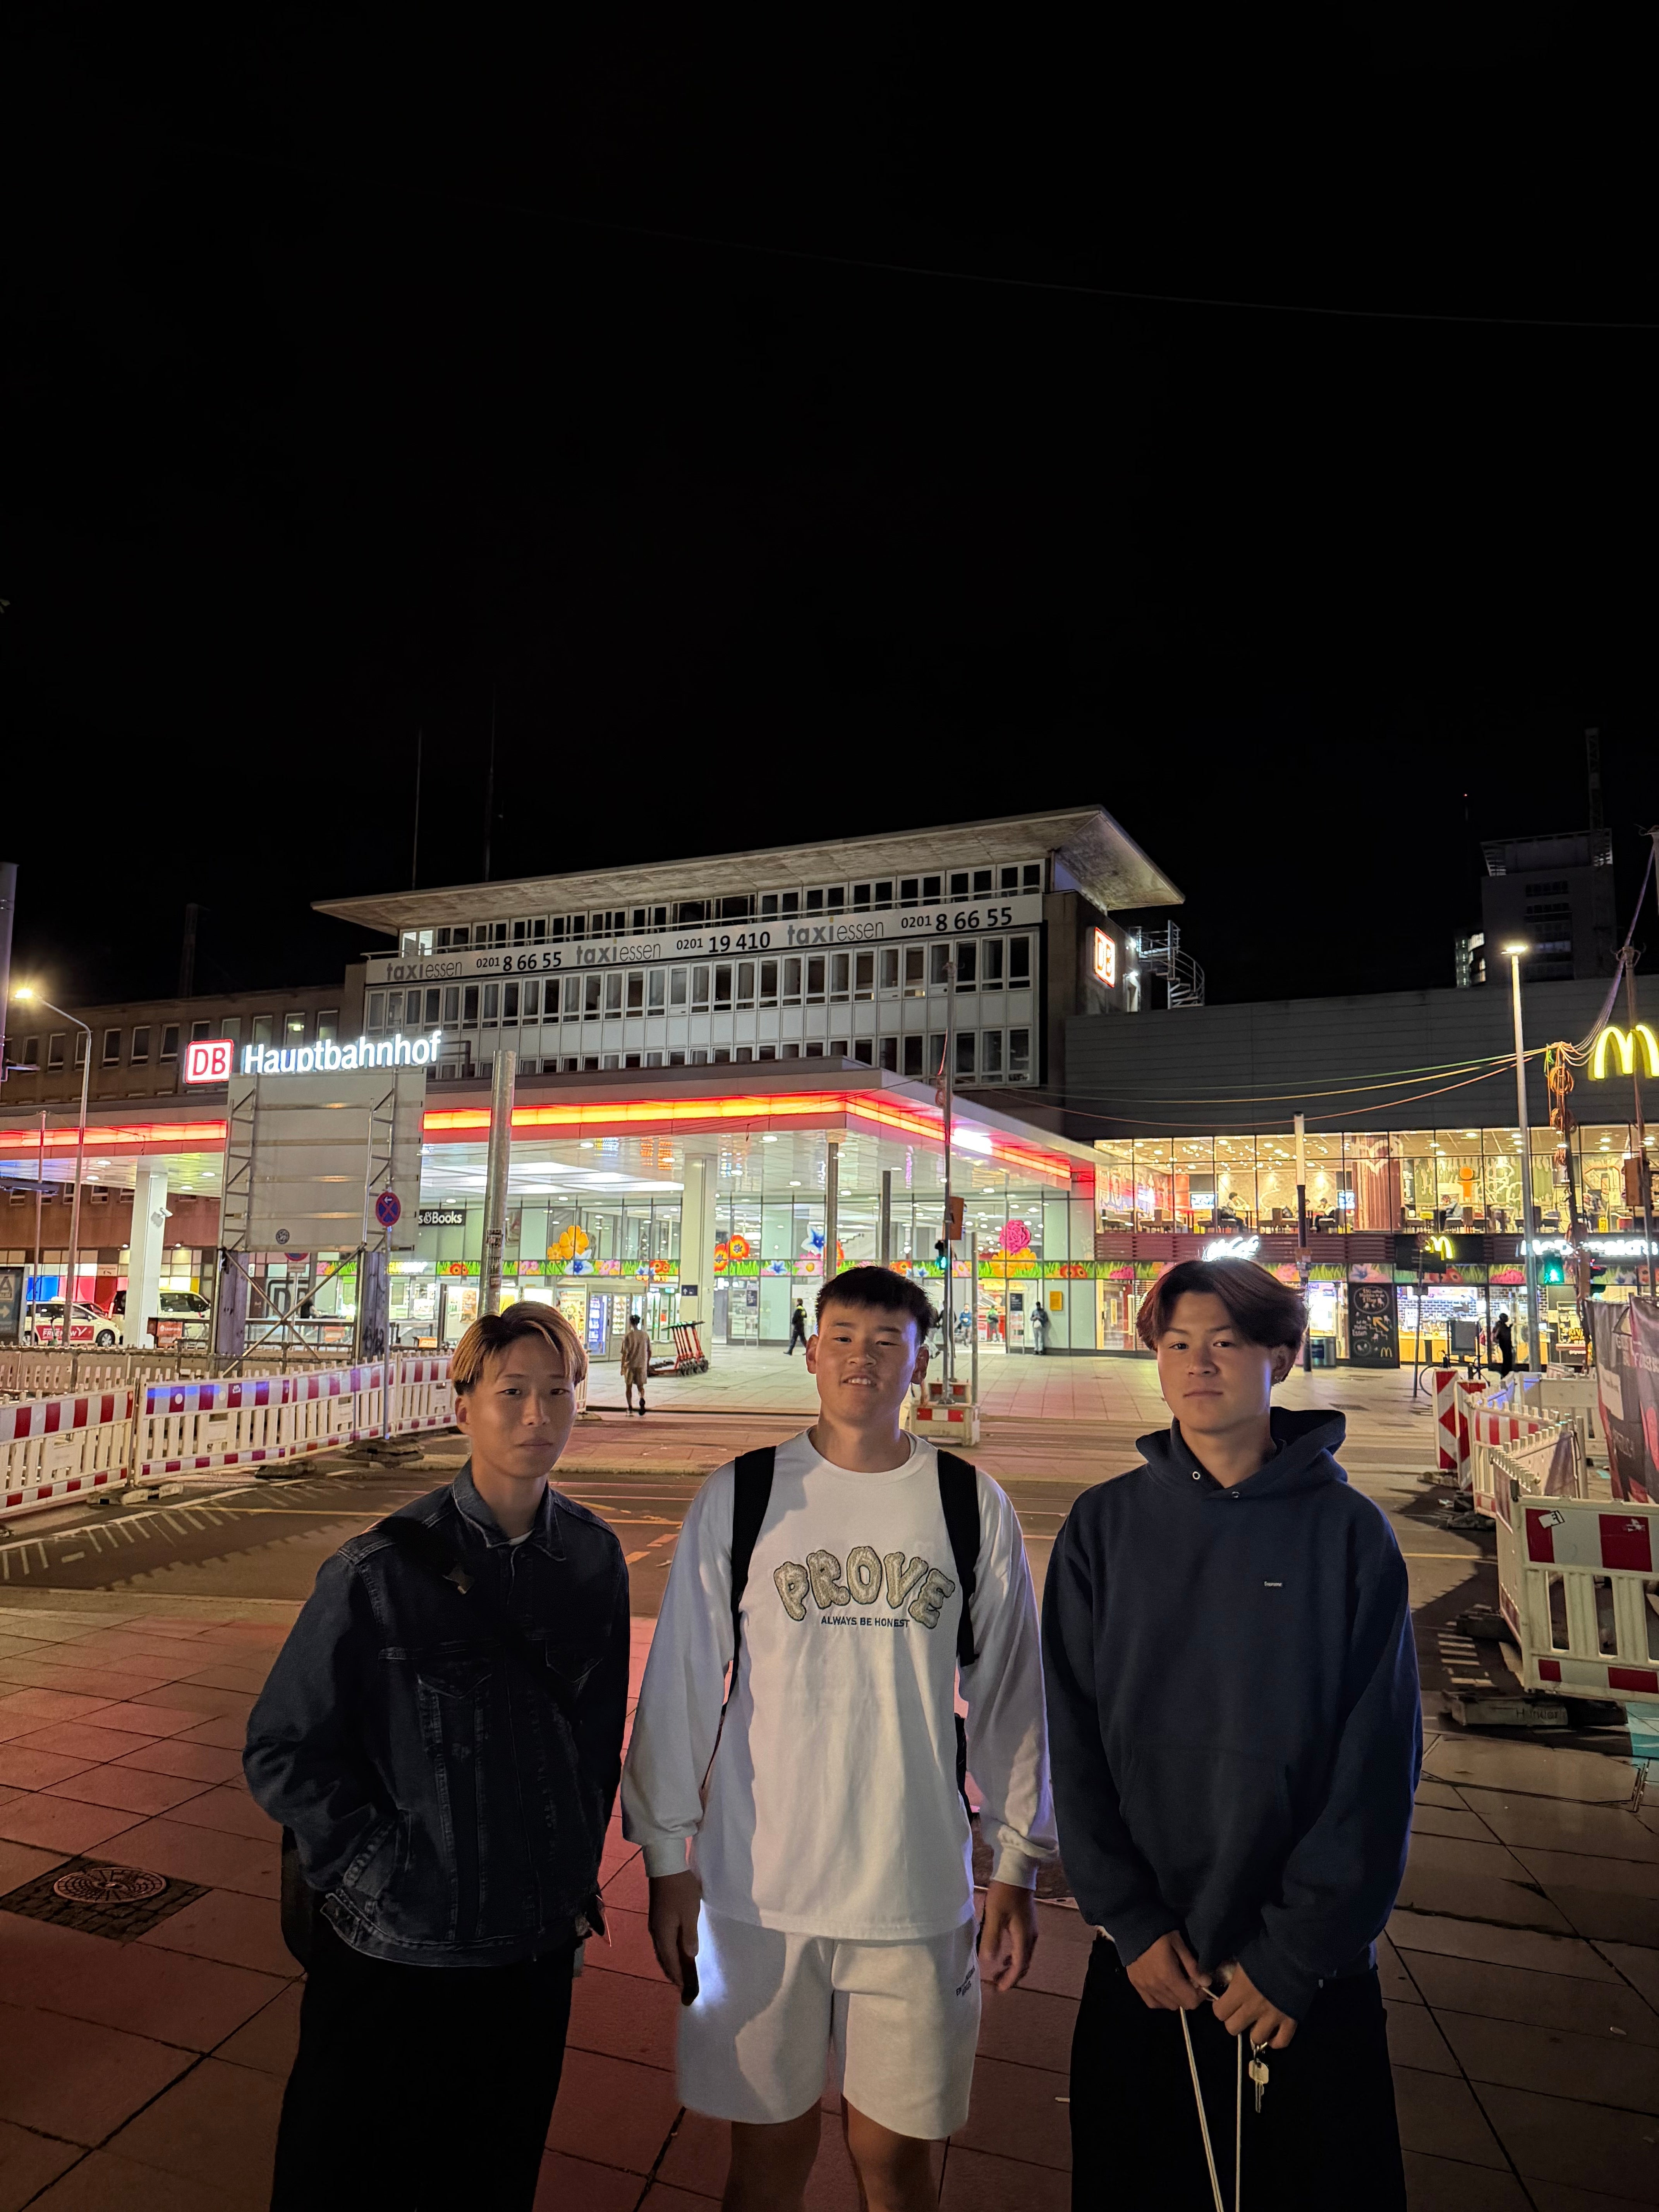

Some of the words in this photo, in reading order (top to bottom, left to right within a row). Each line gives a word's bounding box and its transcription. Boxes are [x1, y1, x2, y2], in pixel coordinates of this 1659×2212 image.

[476, 957, 500, 969] 0201
[677, 938, 703, 951] 0201
[709, 935, 730, 953] 19
[736, 931, 771, 950] 410
[901, 915, 932, 929] 0201
[193, 1048, 225, 1076] DB
[244, 1030, 442, 1073] Hauptbahnhof
[1520, 1239, 1659, 1255] McDnald's
[773, 1546, 955, 1629] PROVE
[821, 1616, 857, 1626] ALWAYS
[875, 1618, 910, 1627] HONEST
